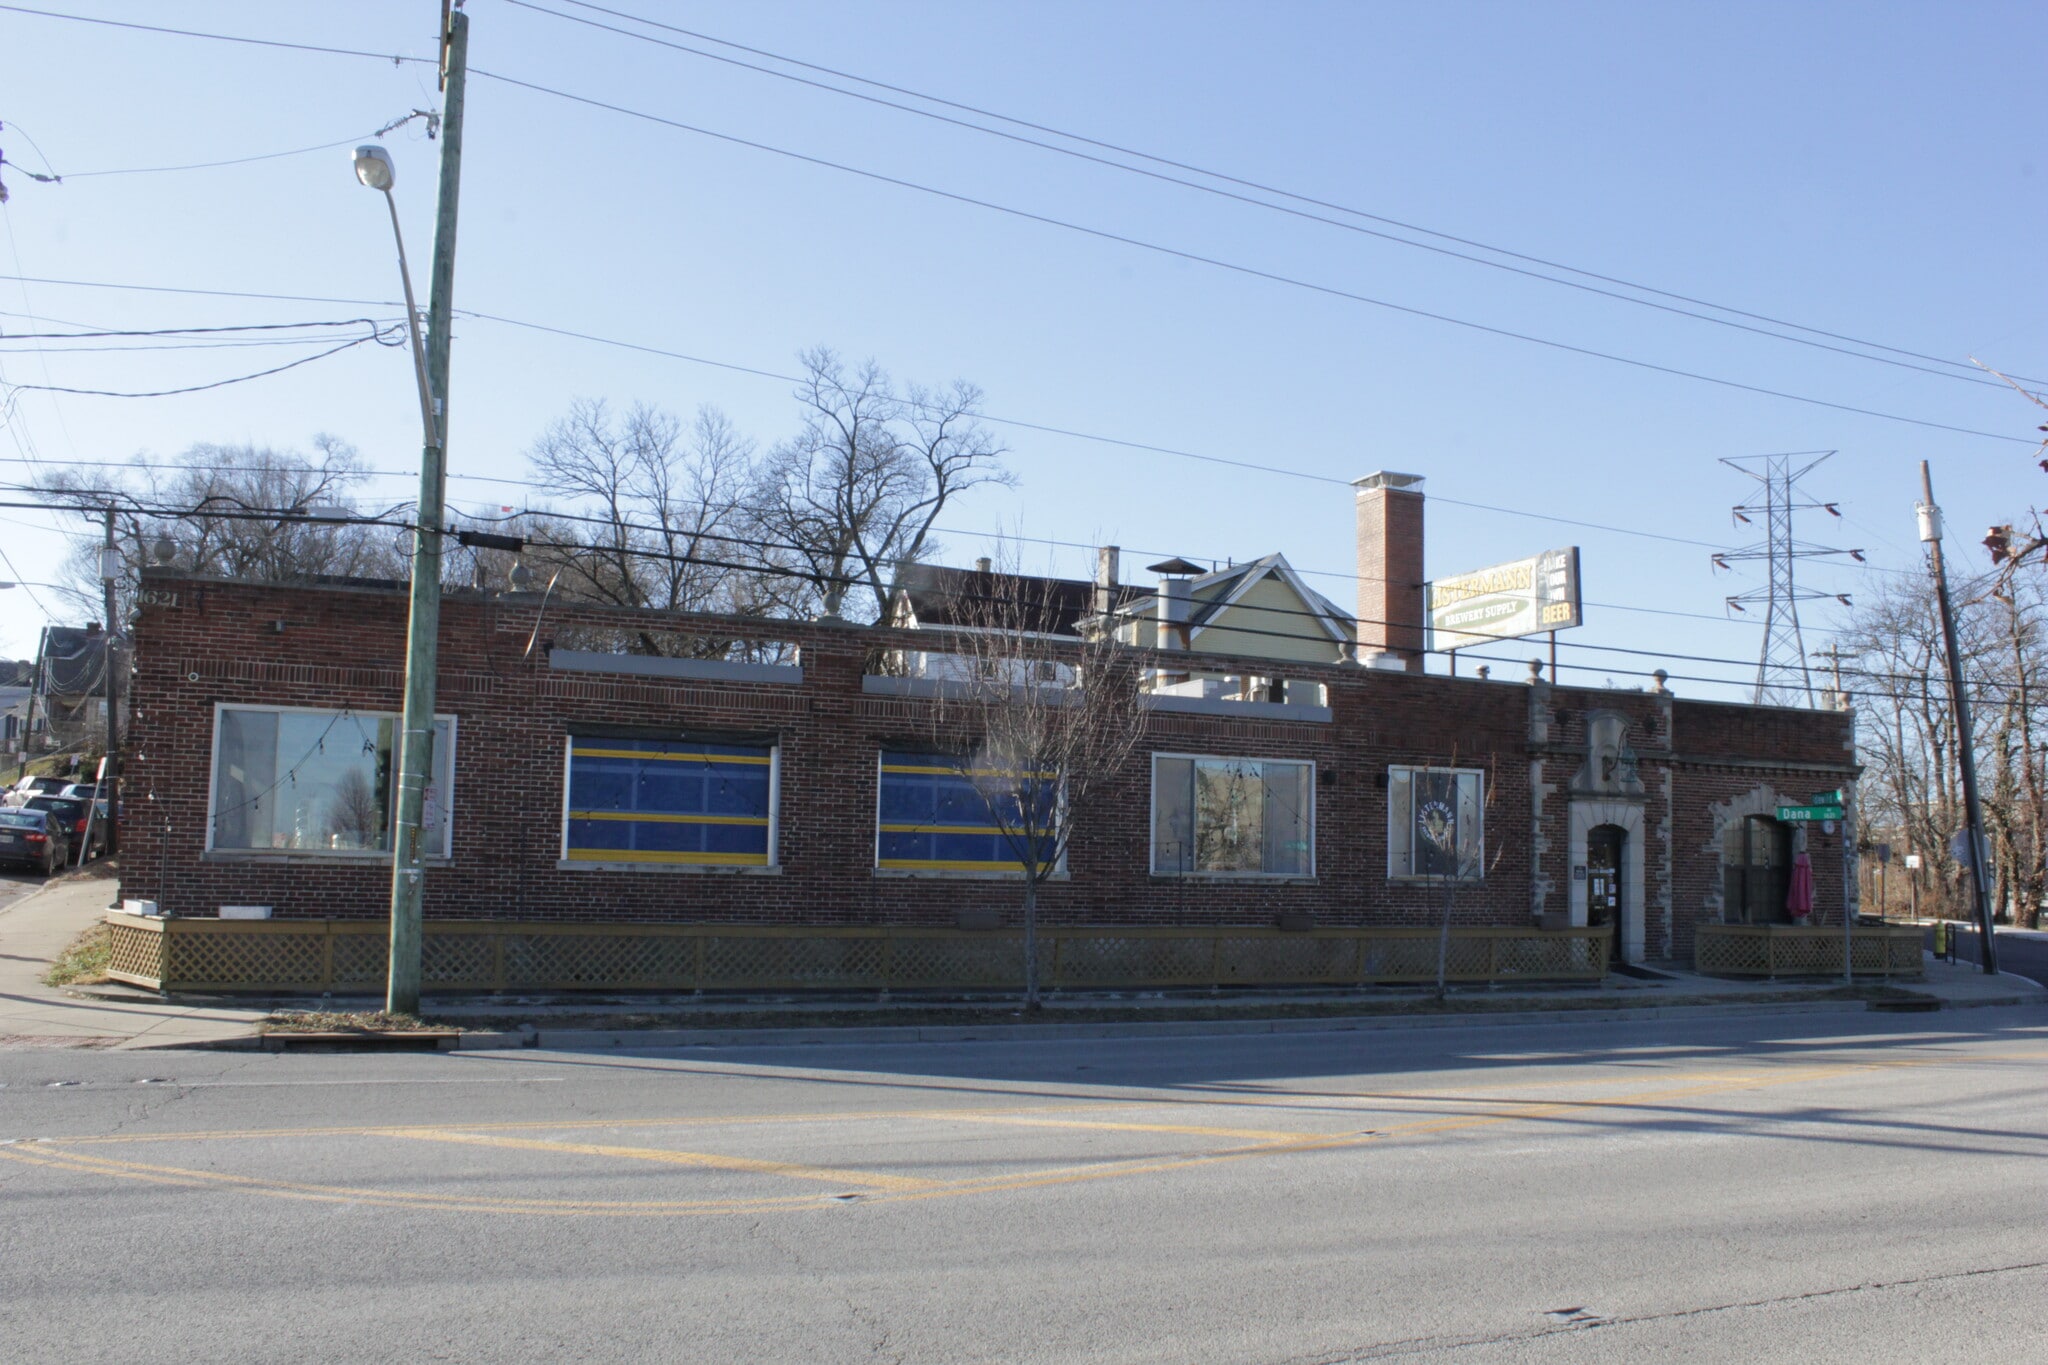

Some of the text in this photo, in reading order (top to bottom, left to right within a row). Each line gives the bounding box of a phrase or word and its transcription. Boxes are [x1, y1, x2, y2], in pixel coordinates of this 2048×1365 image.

[137, 589, 178, 608] 1621
[1428, 565, 1533, 610] LISTERMANN
[1445, 601, 1518, 627] BREWERY SUPPLY
[1542, 602, 1571, 624] BEER
[1783, 808, 1811, 819] Dana
